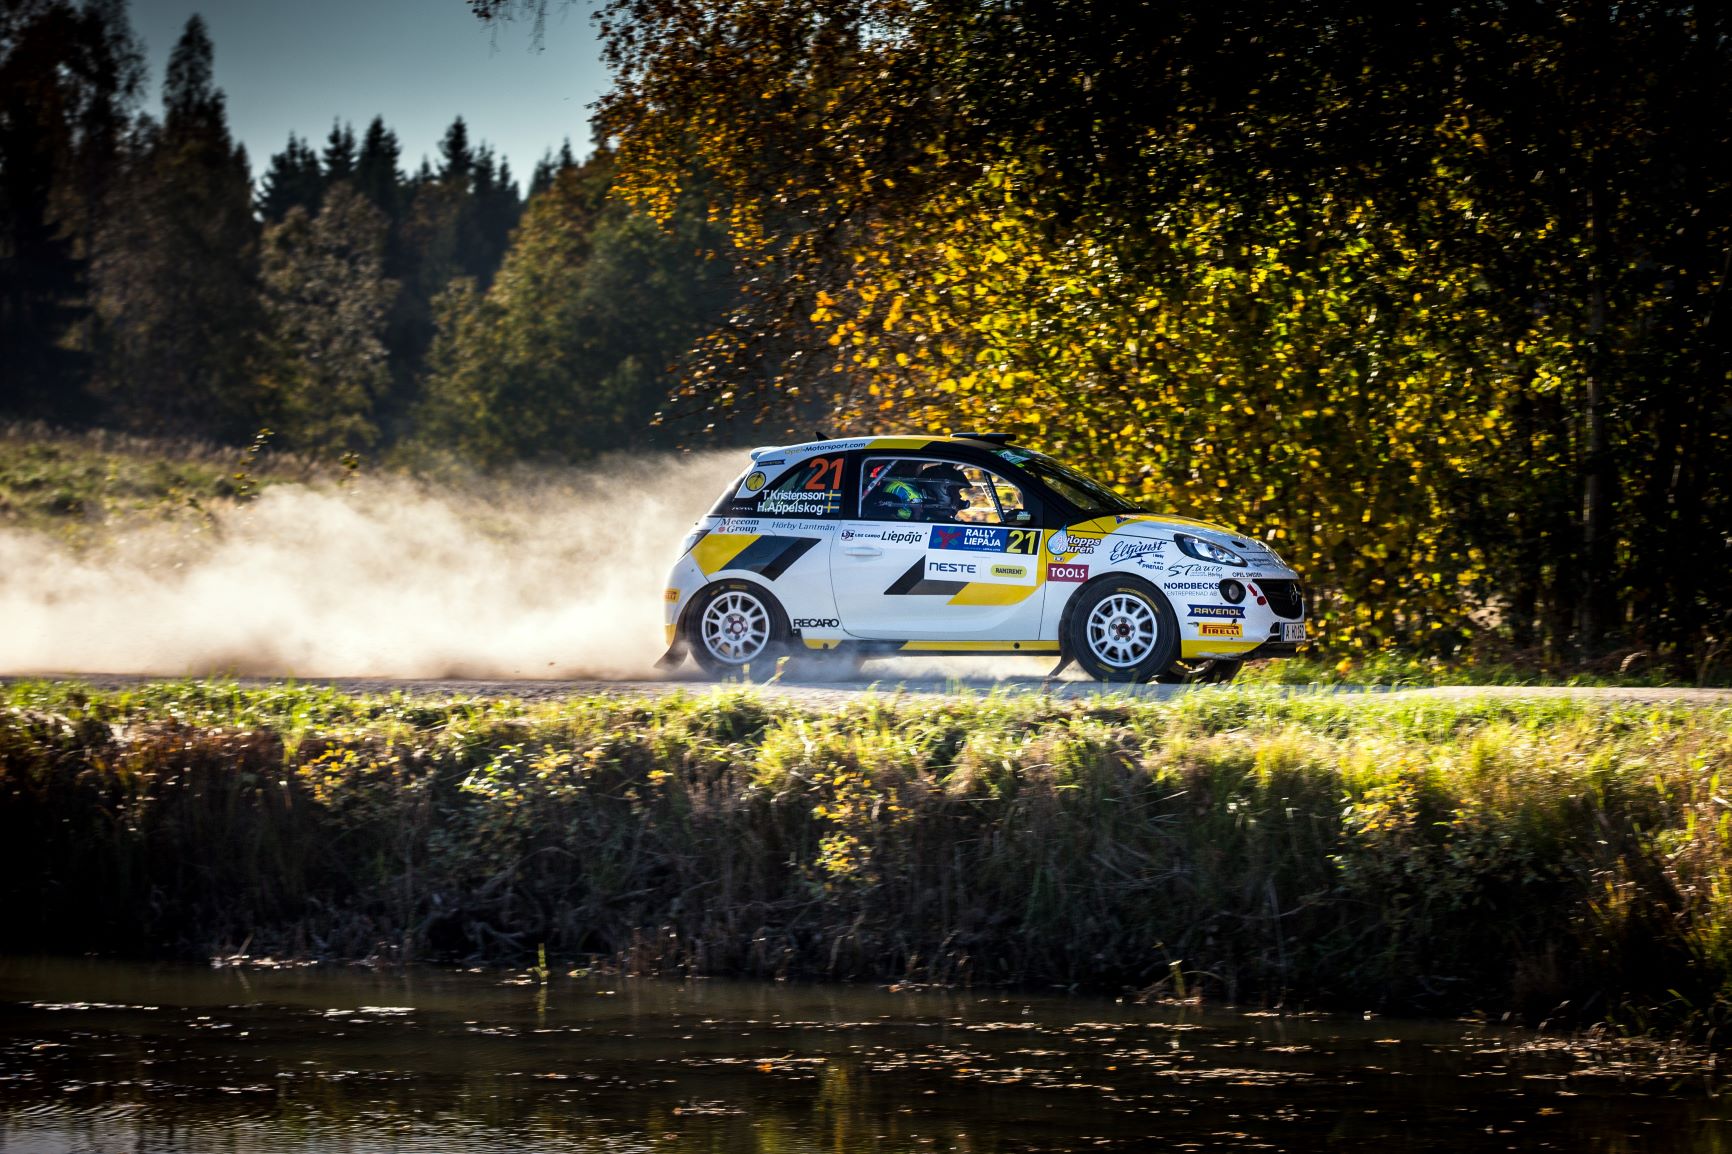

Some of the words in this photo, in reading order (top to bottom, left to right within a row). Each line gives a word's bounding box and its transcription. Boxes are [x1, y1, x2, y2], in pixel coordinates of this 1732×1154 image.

[804, 457, 844, 490] 21
[762, 489, 825, 501] T.Kristensson
[757, 501, 823, 515] H.Appelskog
[726, 524, 757, 534] Group
[965, 528, 996, 538] RALLY
[1006, 530, 1037, 555] 21
[1050, 567, 1085, 579] TOOLS
[1163, 582, 1220, 590] NORDBECKS
[1193, 607, 1241, 616] RAVENOL
[793, 618, 840, 628] RECARO
[1202, 624, 1240, 635] PIRELLI
